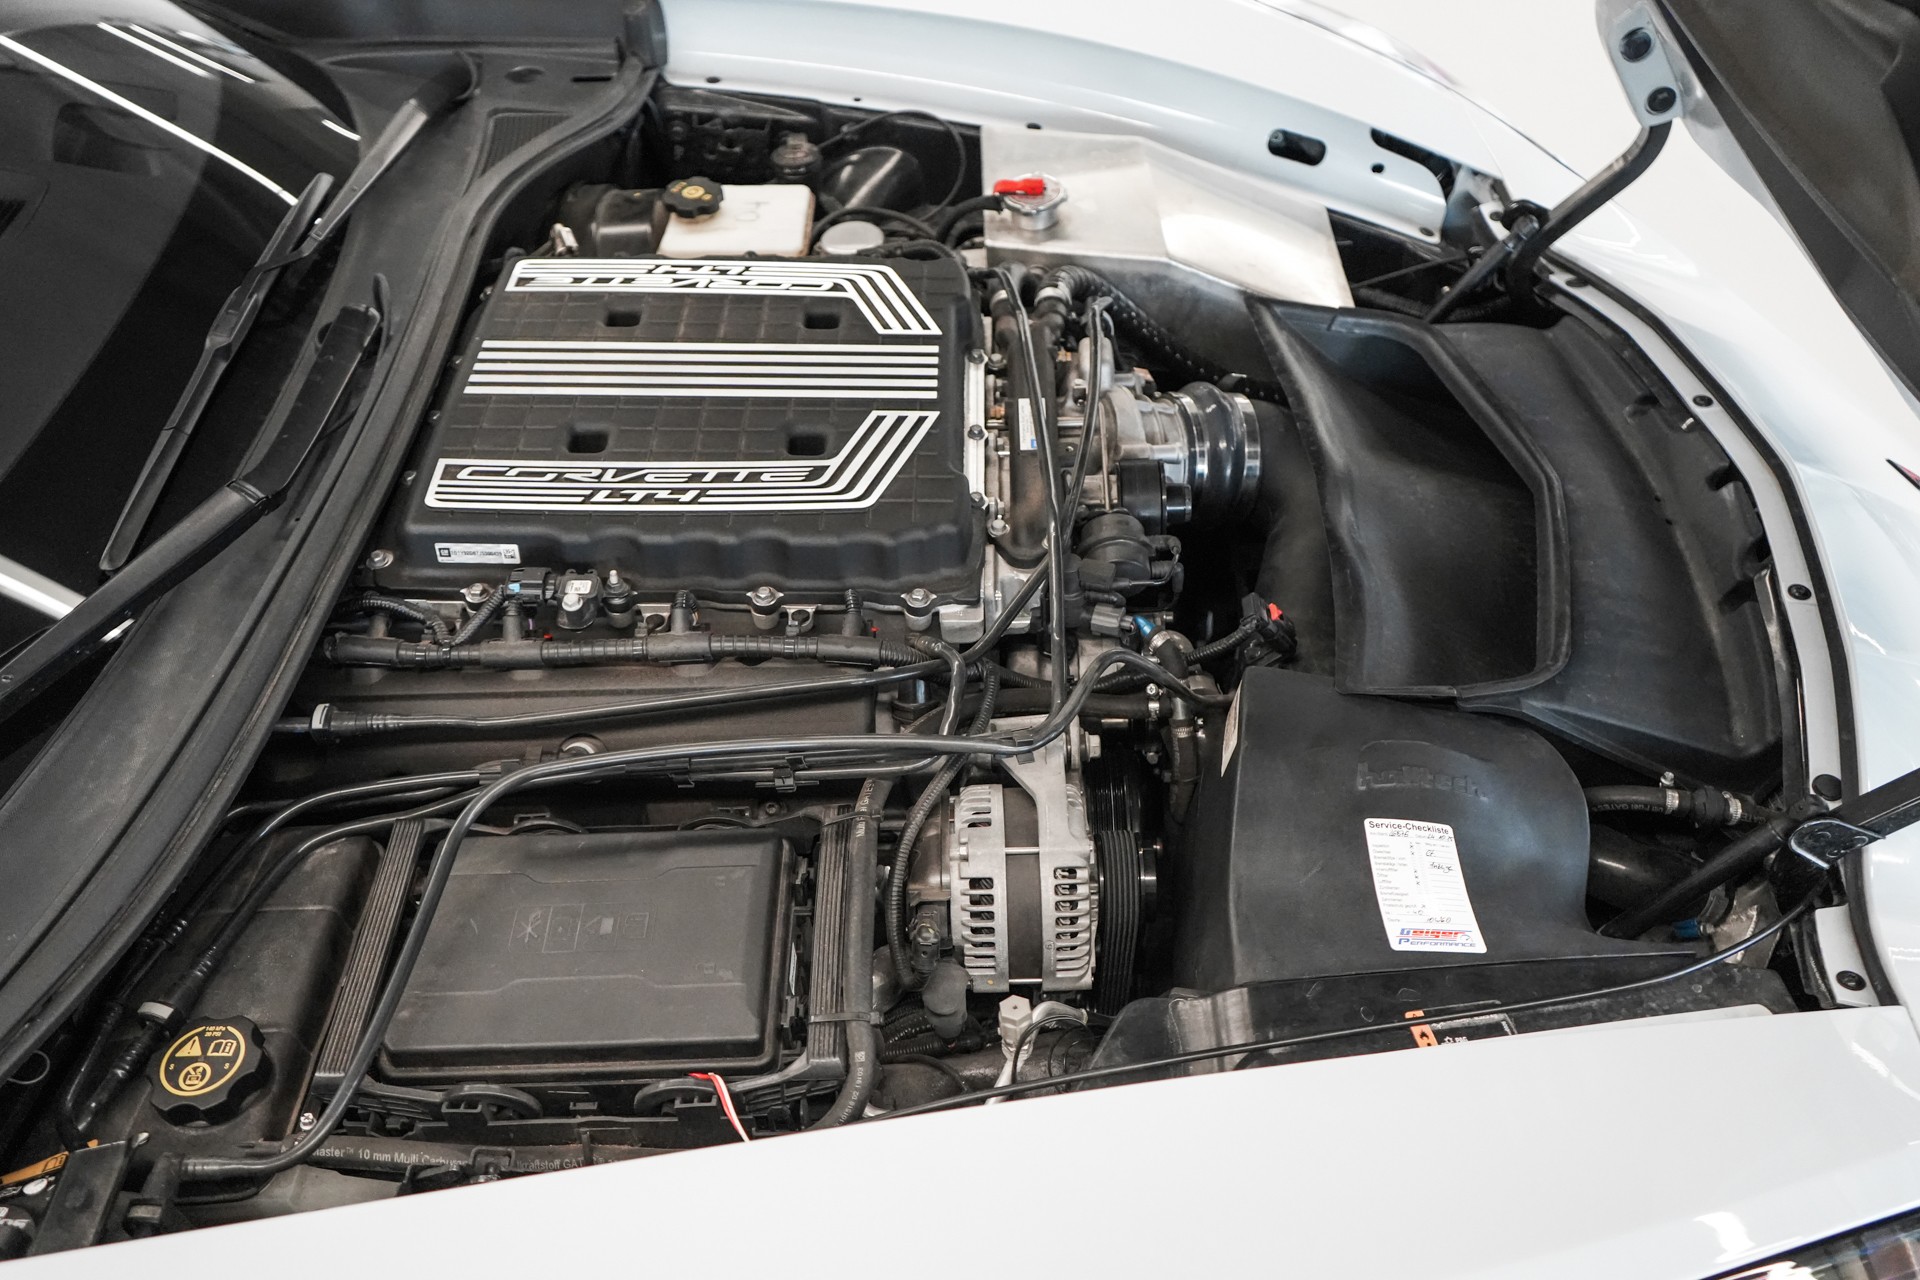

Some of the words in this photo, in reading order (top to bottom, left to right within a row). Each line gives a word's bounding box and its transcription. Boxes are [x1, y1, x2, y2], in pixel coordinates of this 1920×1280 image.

[651, 263, 751, 275] LT4
[528, 276, 838, 292] CORVETTE
[456, 465, 815, 484] CORVETTE
[589, 488, 701, 503] LT4
[1368, 820, 1449, 835] Service-Checkliste
[358, 1148, 370, 1161] 10
[372, 1152, 391, 1162] mm
[394, 1151, 419, 1164] Multi
